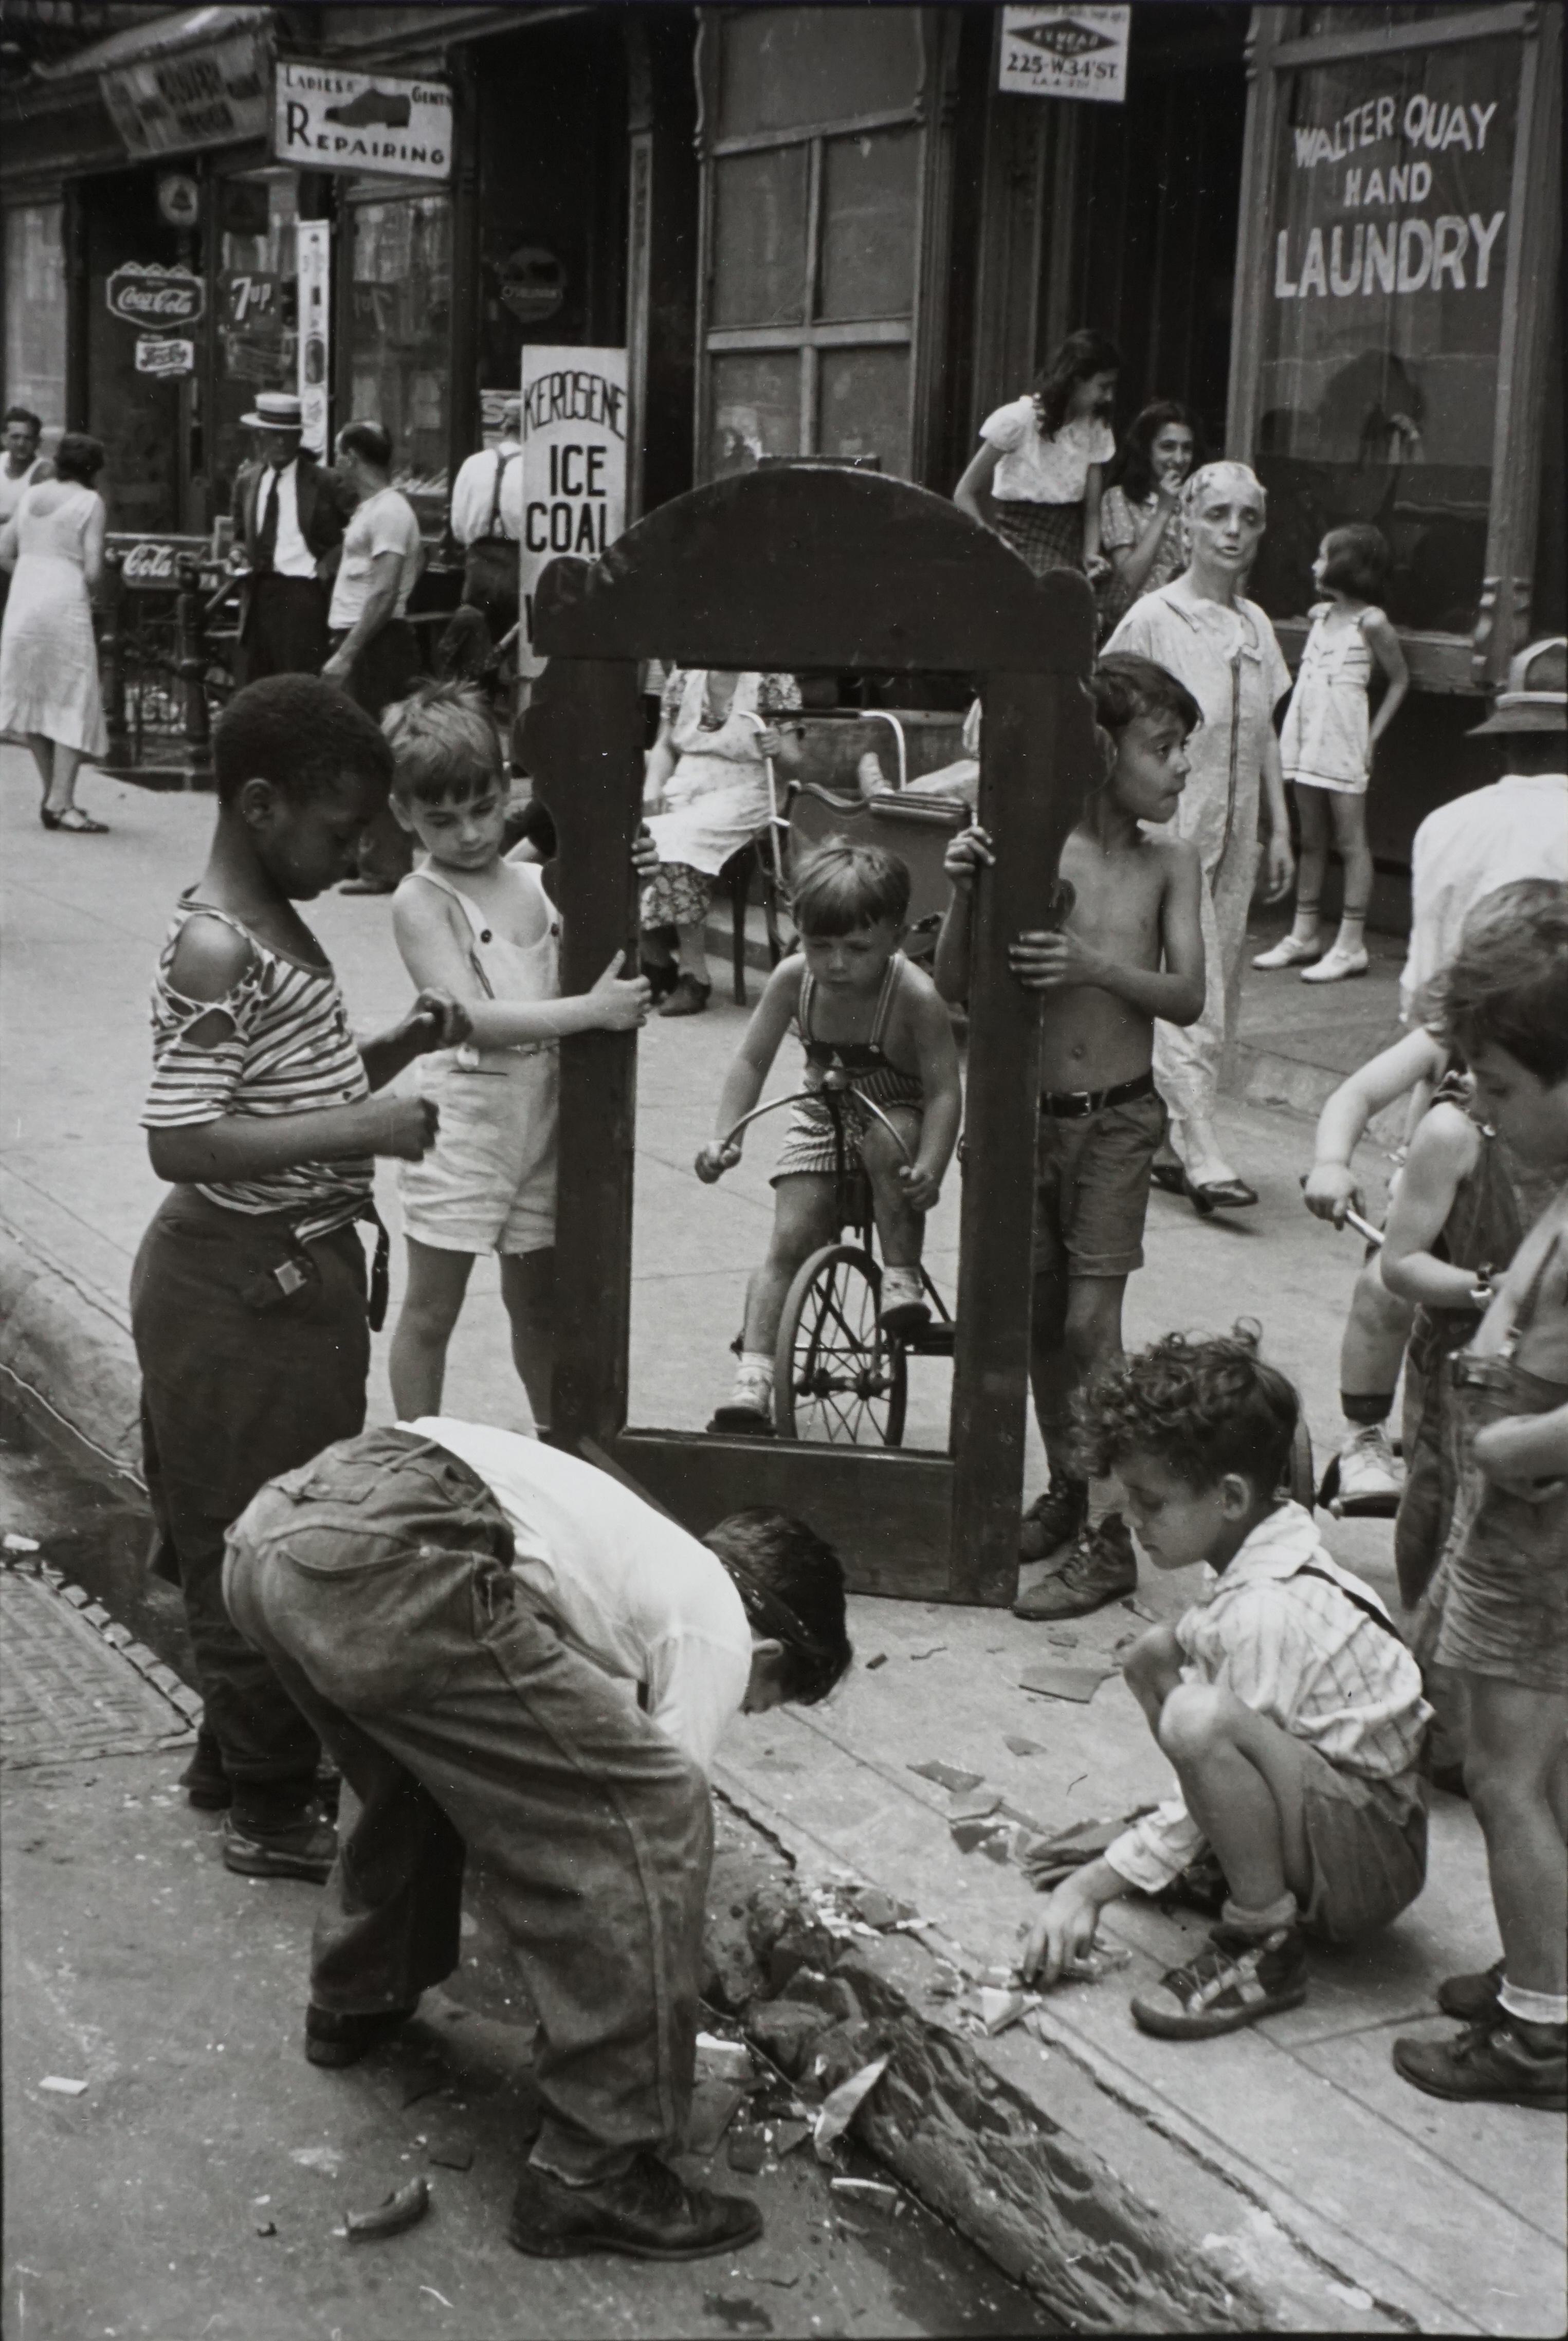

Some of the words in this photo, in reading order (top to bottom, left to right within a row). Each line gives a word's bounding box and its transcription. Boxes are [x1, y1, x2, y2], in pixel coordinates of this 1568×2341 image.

[287, 101, 445, 165] REPAIRING
[1294, 95, 1396, 169] WALTER
[1403, 94, 1498, 151] QUAY
[1343, 161, 1432, 206] HAND
[1274, 211, 1506, 299] LAUNDRY
[524, 370, 626, 441] KEROSENE
[550, 444, 607, 497] ICE
